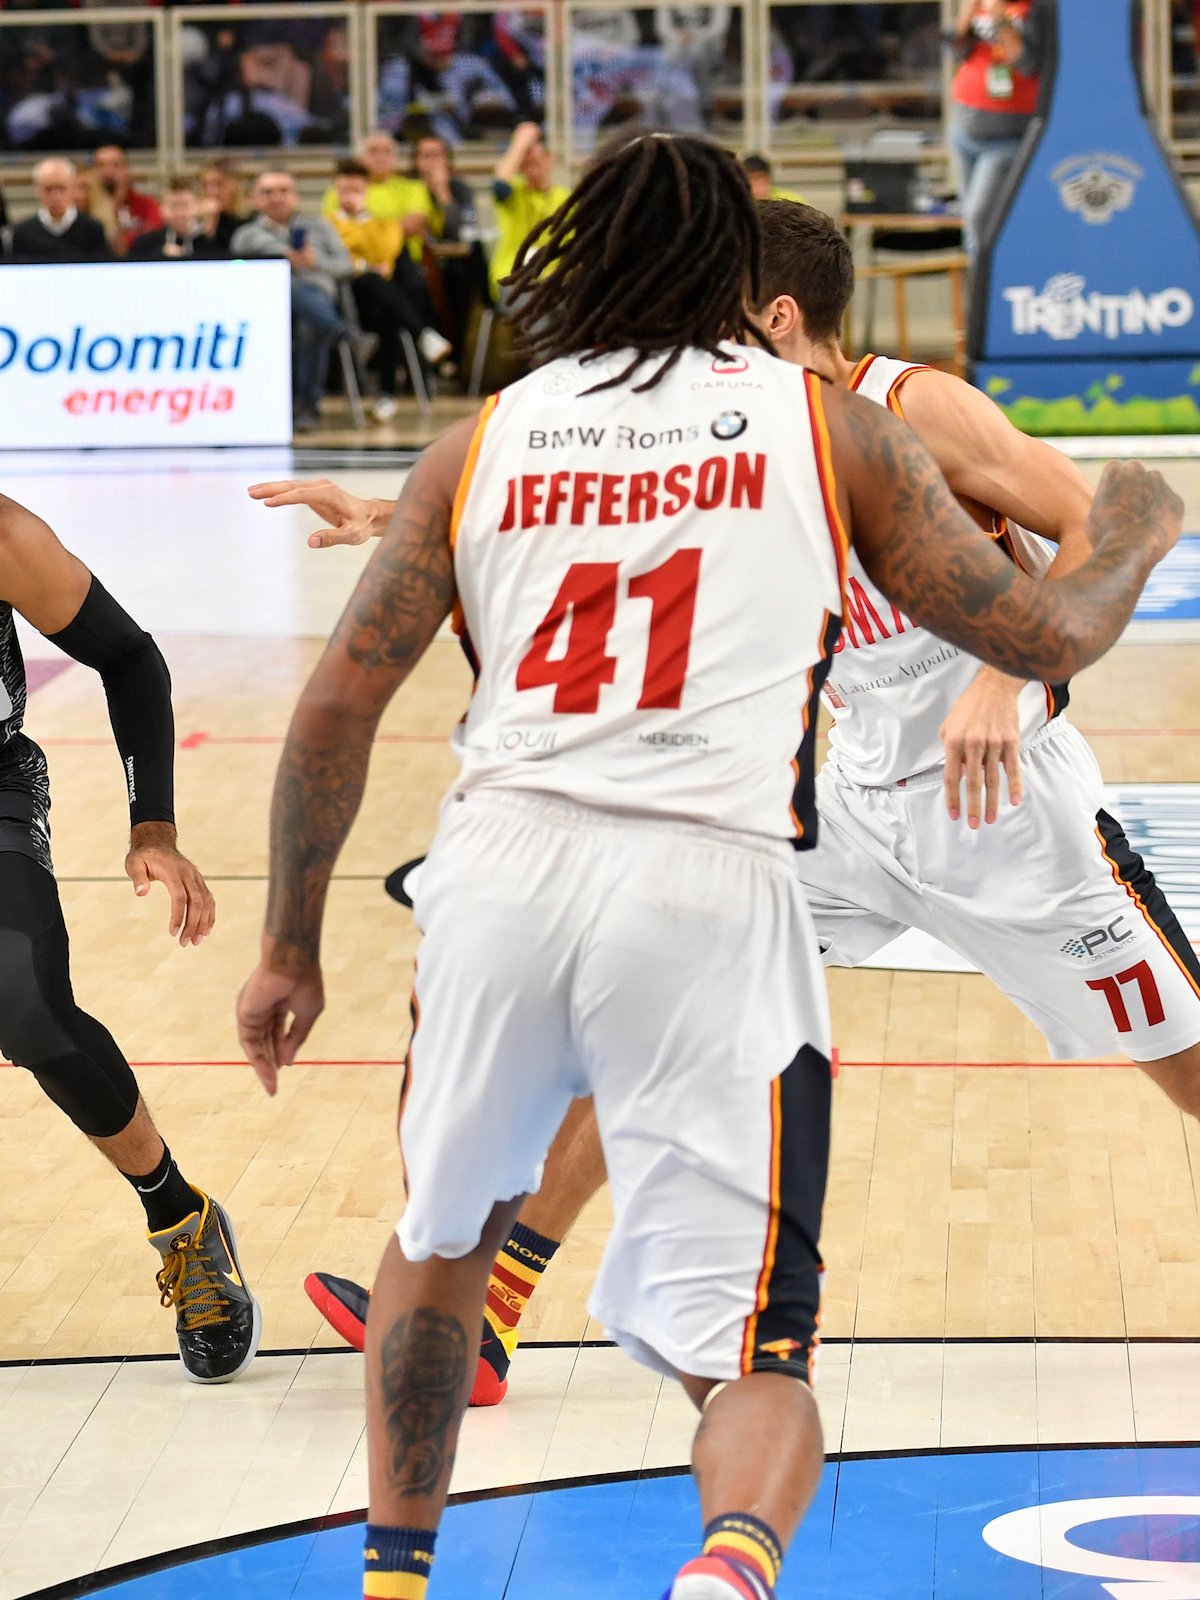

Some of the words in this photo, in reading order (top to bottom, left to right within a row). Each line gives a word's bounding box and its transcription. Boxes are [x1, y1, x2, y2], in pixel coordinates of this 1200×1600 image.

[1003, 273, 1194, 340] TRENTINO
[63, 384, 234, 421] energia
[691, 382, 765, 390] DARUMA
[528, 425, 606, 450] BMW
[499, 452, 767, 532] JEFFERSON
[516, 547, 703, 714] 41
[125, 756, 137, 804] SPALDING
[1081, 915, 1133, 956] PC
